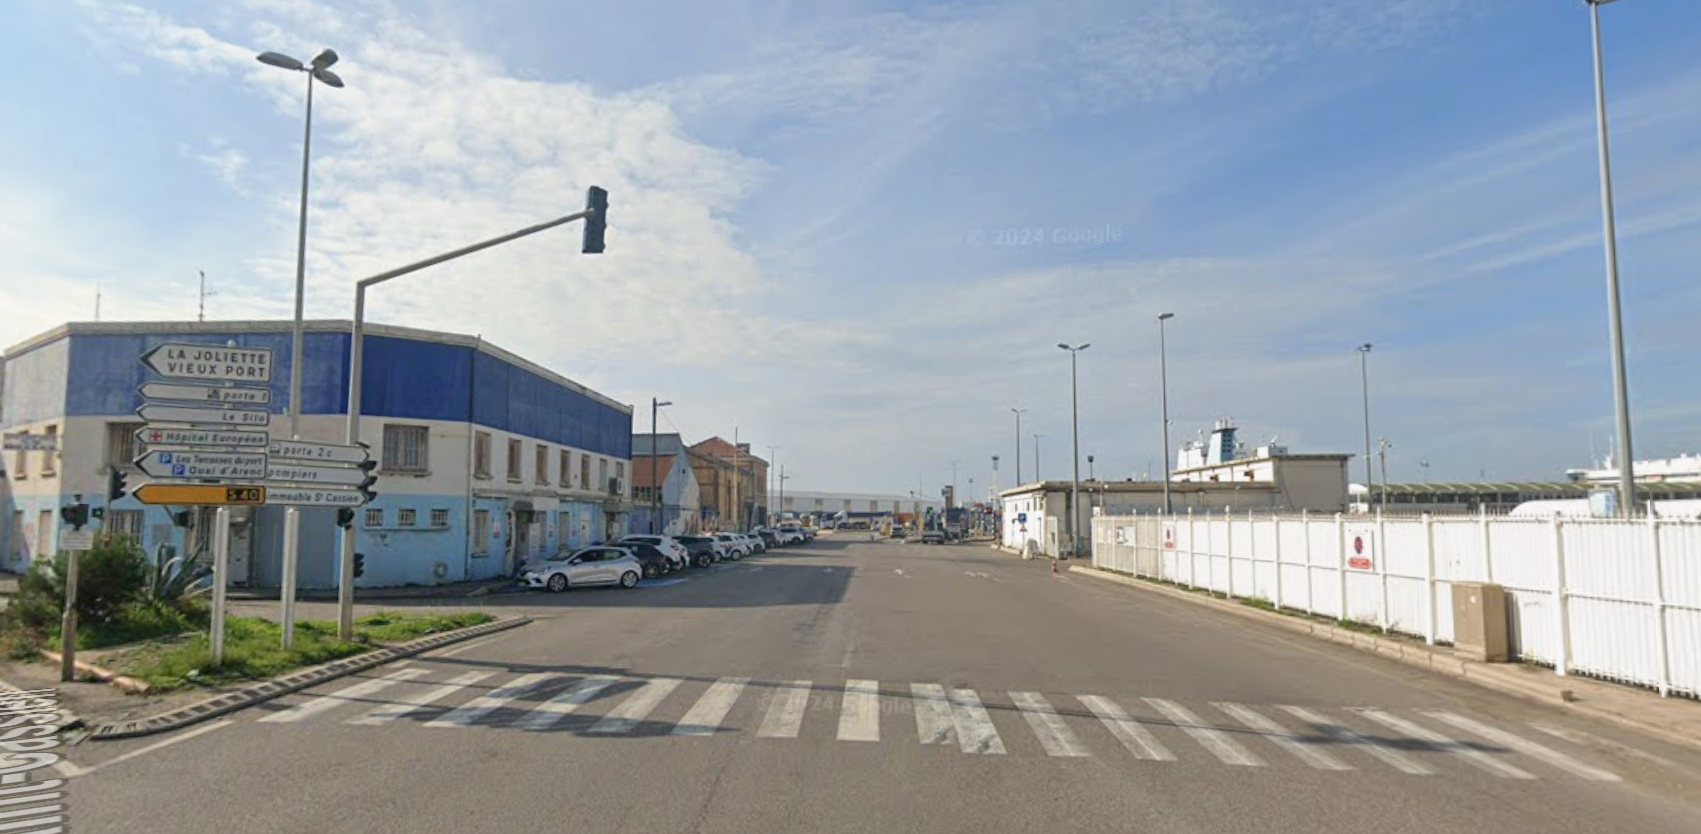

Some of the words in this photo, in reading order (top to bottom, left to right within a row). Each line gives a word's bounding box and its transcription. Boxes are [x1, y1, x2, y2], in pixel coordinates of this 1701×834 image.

[168, 348, 186, 360] LA
[194, 350, 267, 365] JOLIETTE
[167, 362, 217, 375] VIEUX
[225, 366, 266, 378] PORT
[224, 391, 255, 401] porte
[222, 411, 236, 421] Le
[242, 412, 265, 422] Silo
[283, 446, 313, 457] porte
[189, 466, 216, 476] Quai
